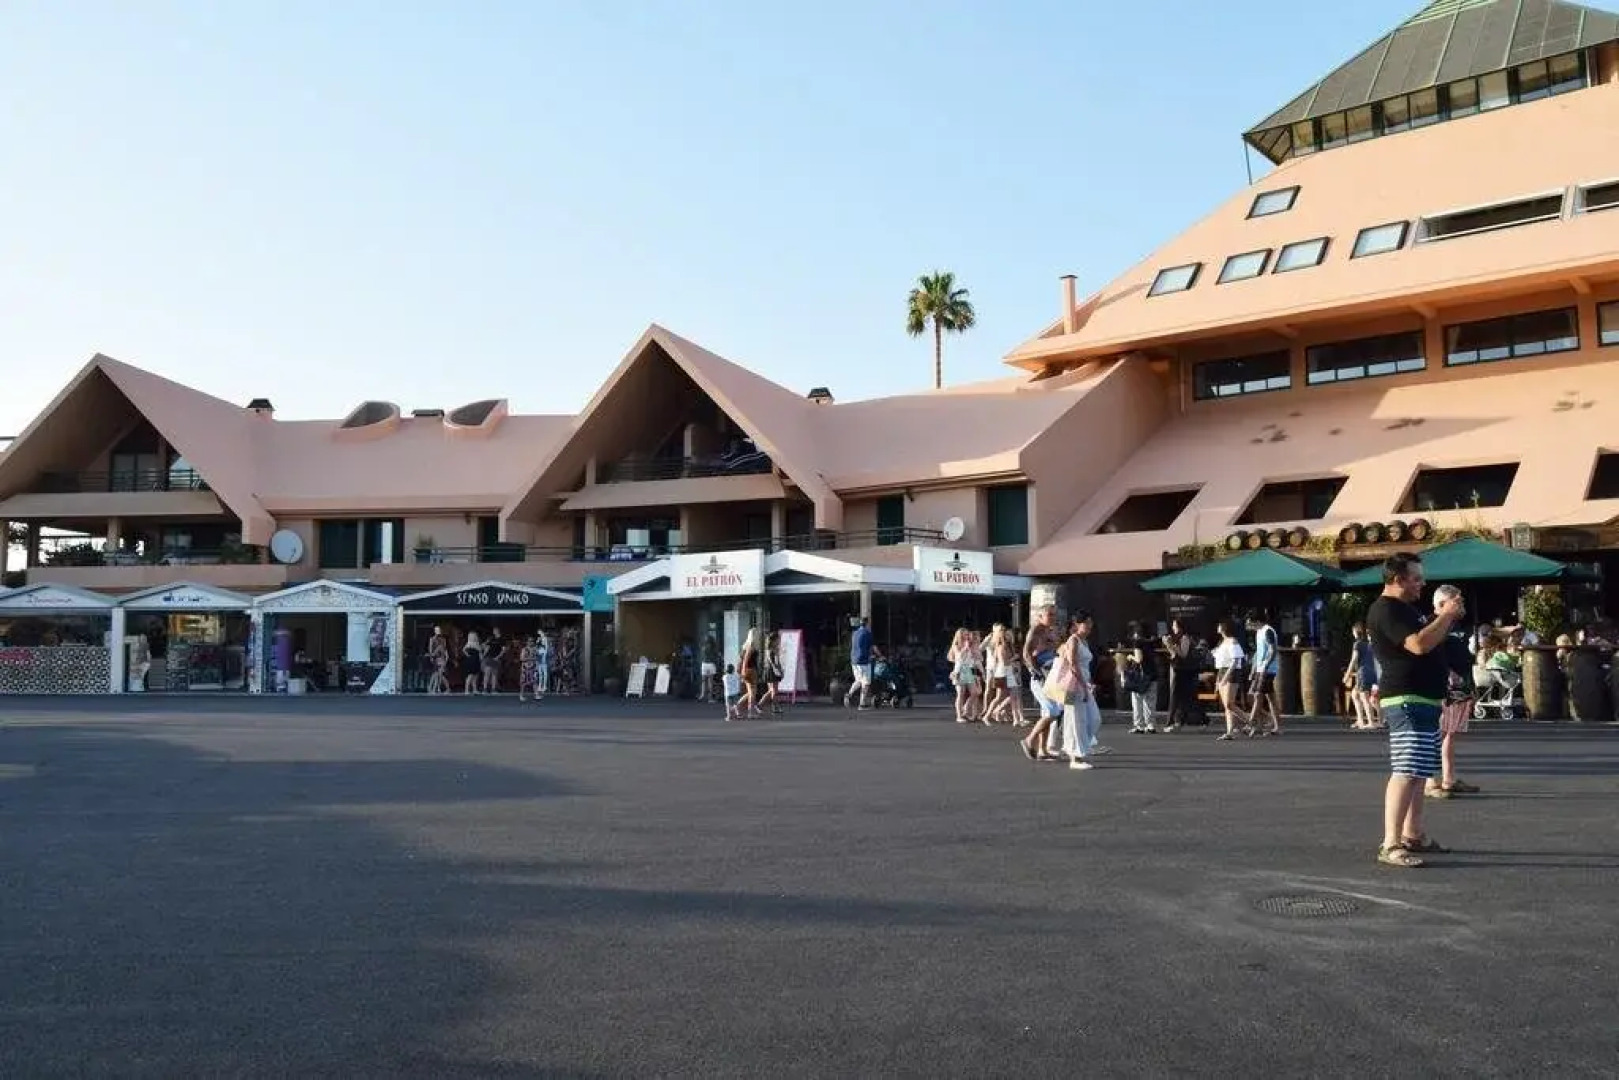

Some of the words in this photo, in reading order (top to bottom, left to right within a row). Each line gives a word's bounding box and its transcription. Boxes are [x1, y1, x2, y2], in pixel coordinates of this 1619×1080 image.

[687, 576, 699, 587] EL
[934, 571, 944, 582] EL
[456, 592, 488, 604] SENSO
[497, 592, 529, 604] UNICO
